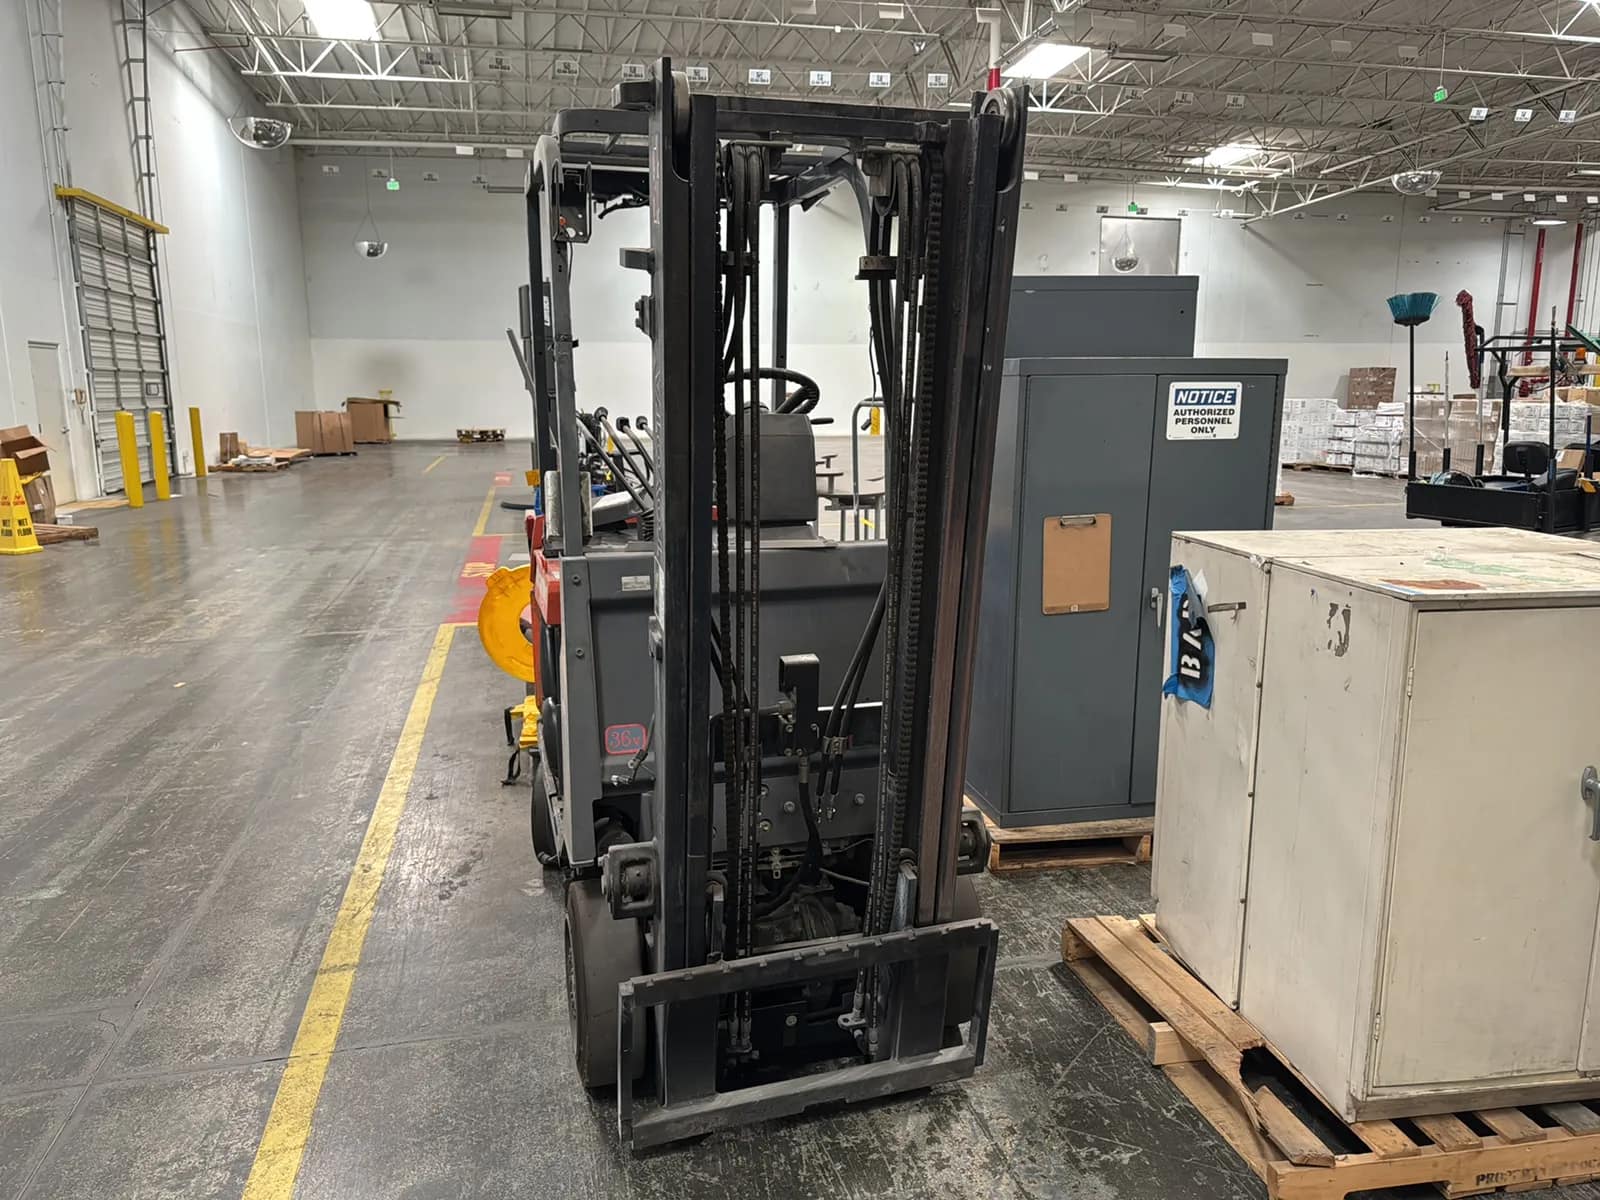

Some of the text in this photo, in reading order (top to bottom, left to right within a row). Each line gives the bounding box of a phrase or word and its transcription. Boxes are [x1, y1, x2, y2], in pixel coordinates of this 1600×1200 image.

[1176, 390, 1235, 404] NOTICE
[1173, 408, 1235, 416] AUTHORIZED
[1175, 417, 1232, 425] PERSONNEL
[1191, 426, 1216, 434] ONLY
